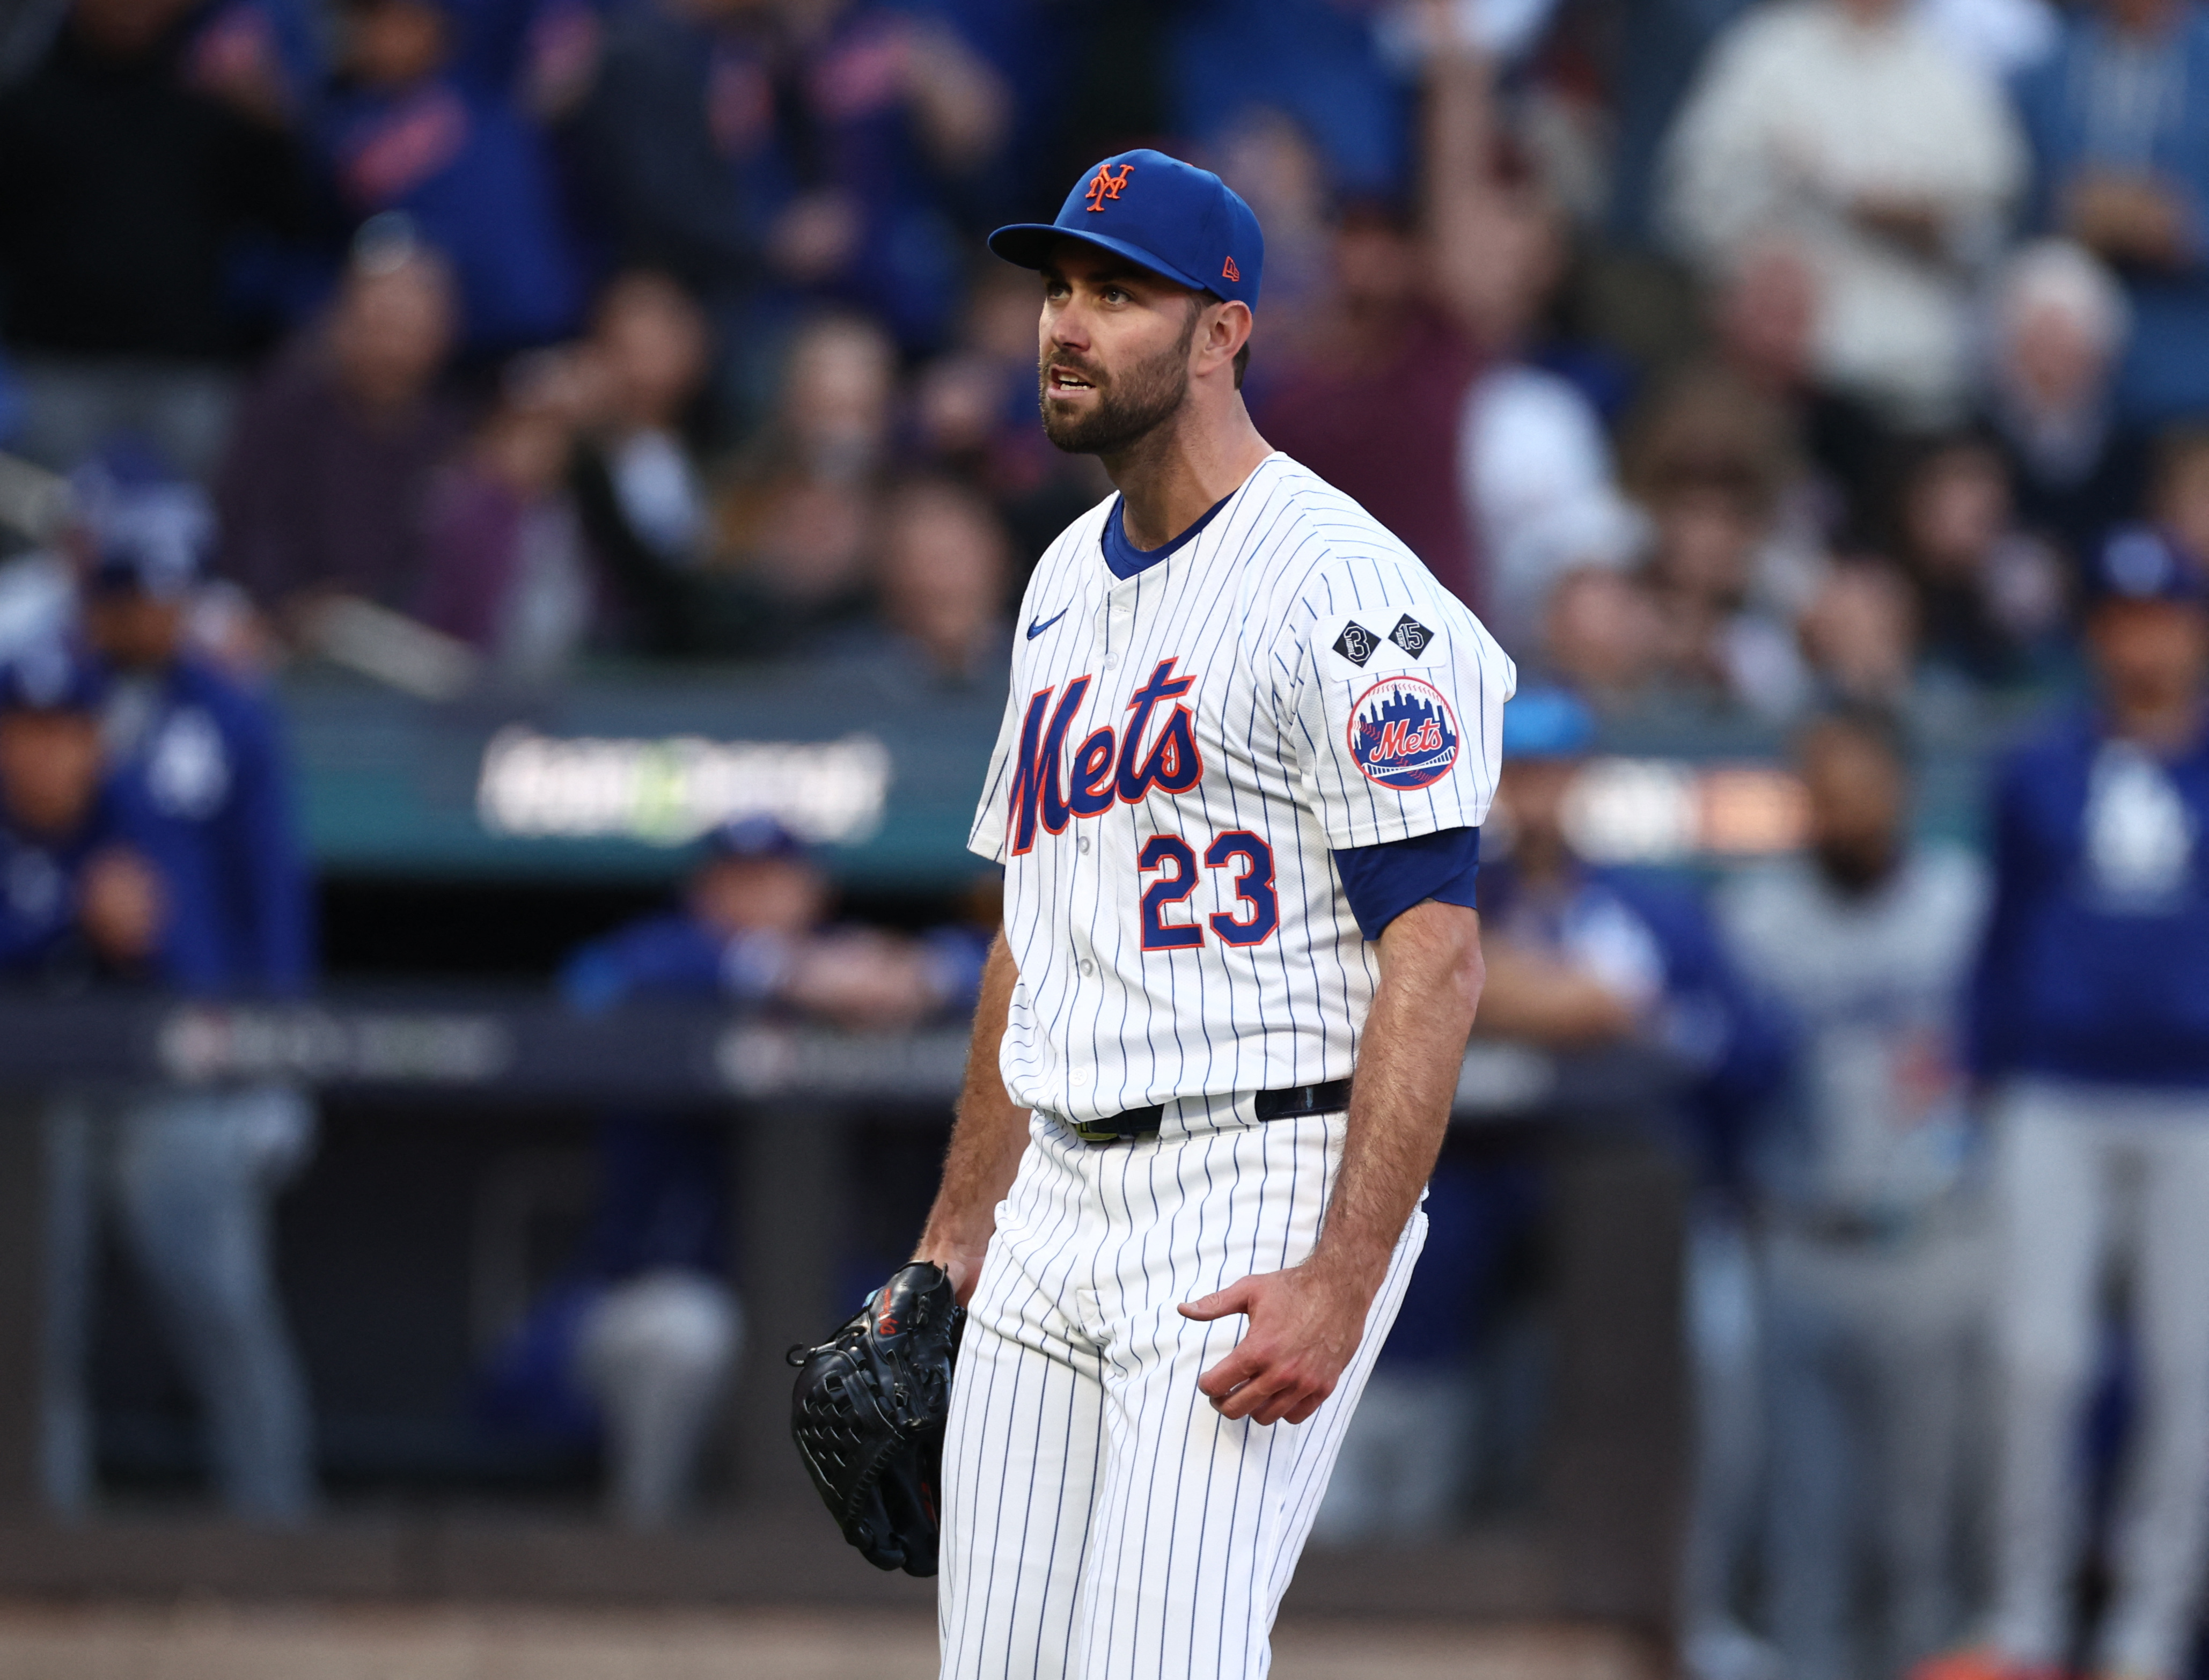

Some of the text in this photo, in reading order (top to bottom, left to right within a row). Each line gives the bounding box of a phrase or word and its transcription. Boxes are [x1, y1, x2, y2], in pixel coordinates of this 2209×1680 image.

[1344, 626, 1371, 662] 3
[1398, 622, 1424, 650] 15
[1006, 656, 1203, 856] Mets
[1369, 718, 1442, 762] Mets
[1137, 830, 1280, 952] 23
